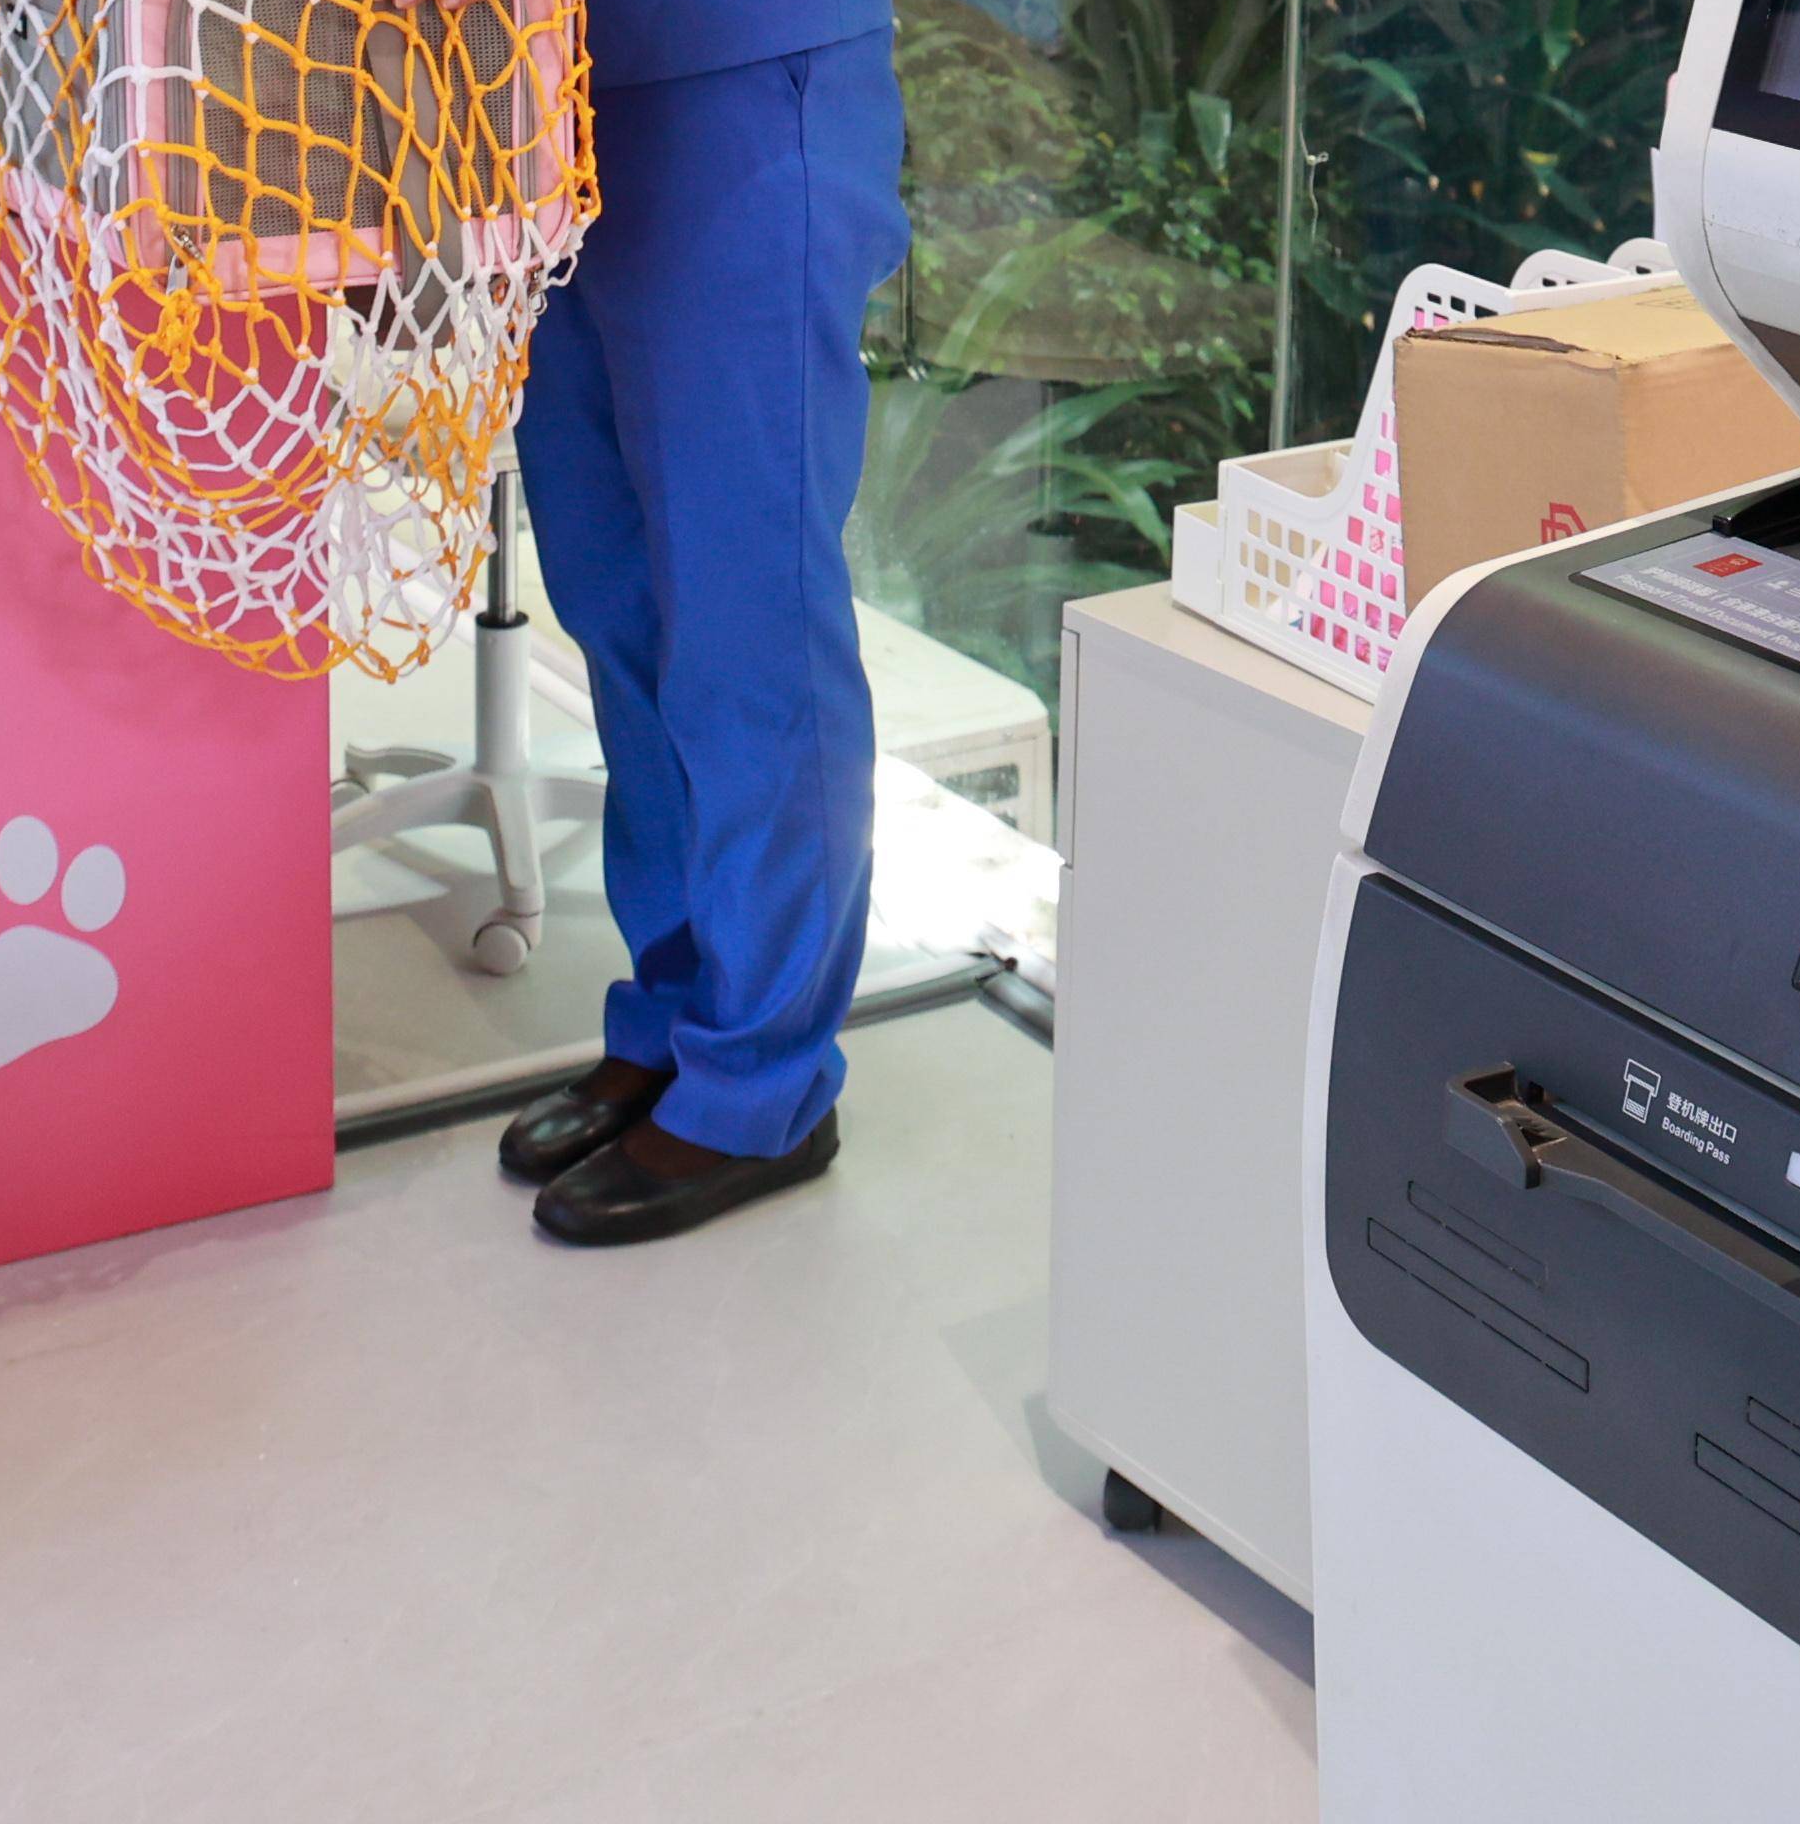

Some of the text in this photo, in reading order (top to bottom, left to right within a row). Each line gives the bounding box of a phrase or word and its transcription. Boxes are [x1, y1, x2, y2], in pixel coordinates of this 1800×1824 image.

[1661, 1116, 1731, 1165] Boarding Pass
[1666, 1091, 1738, 1144] 登机牌出口
